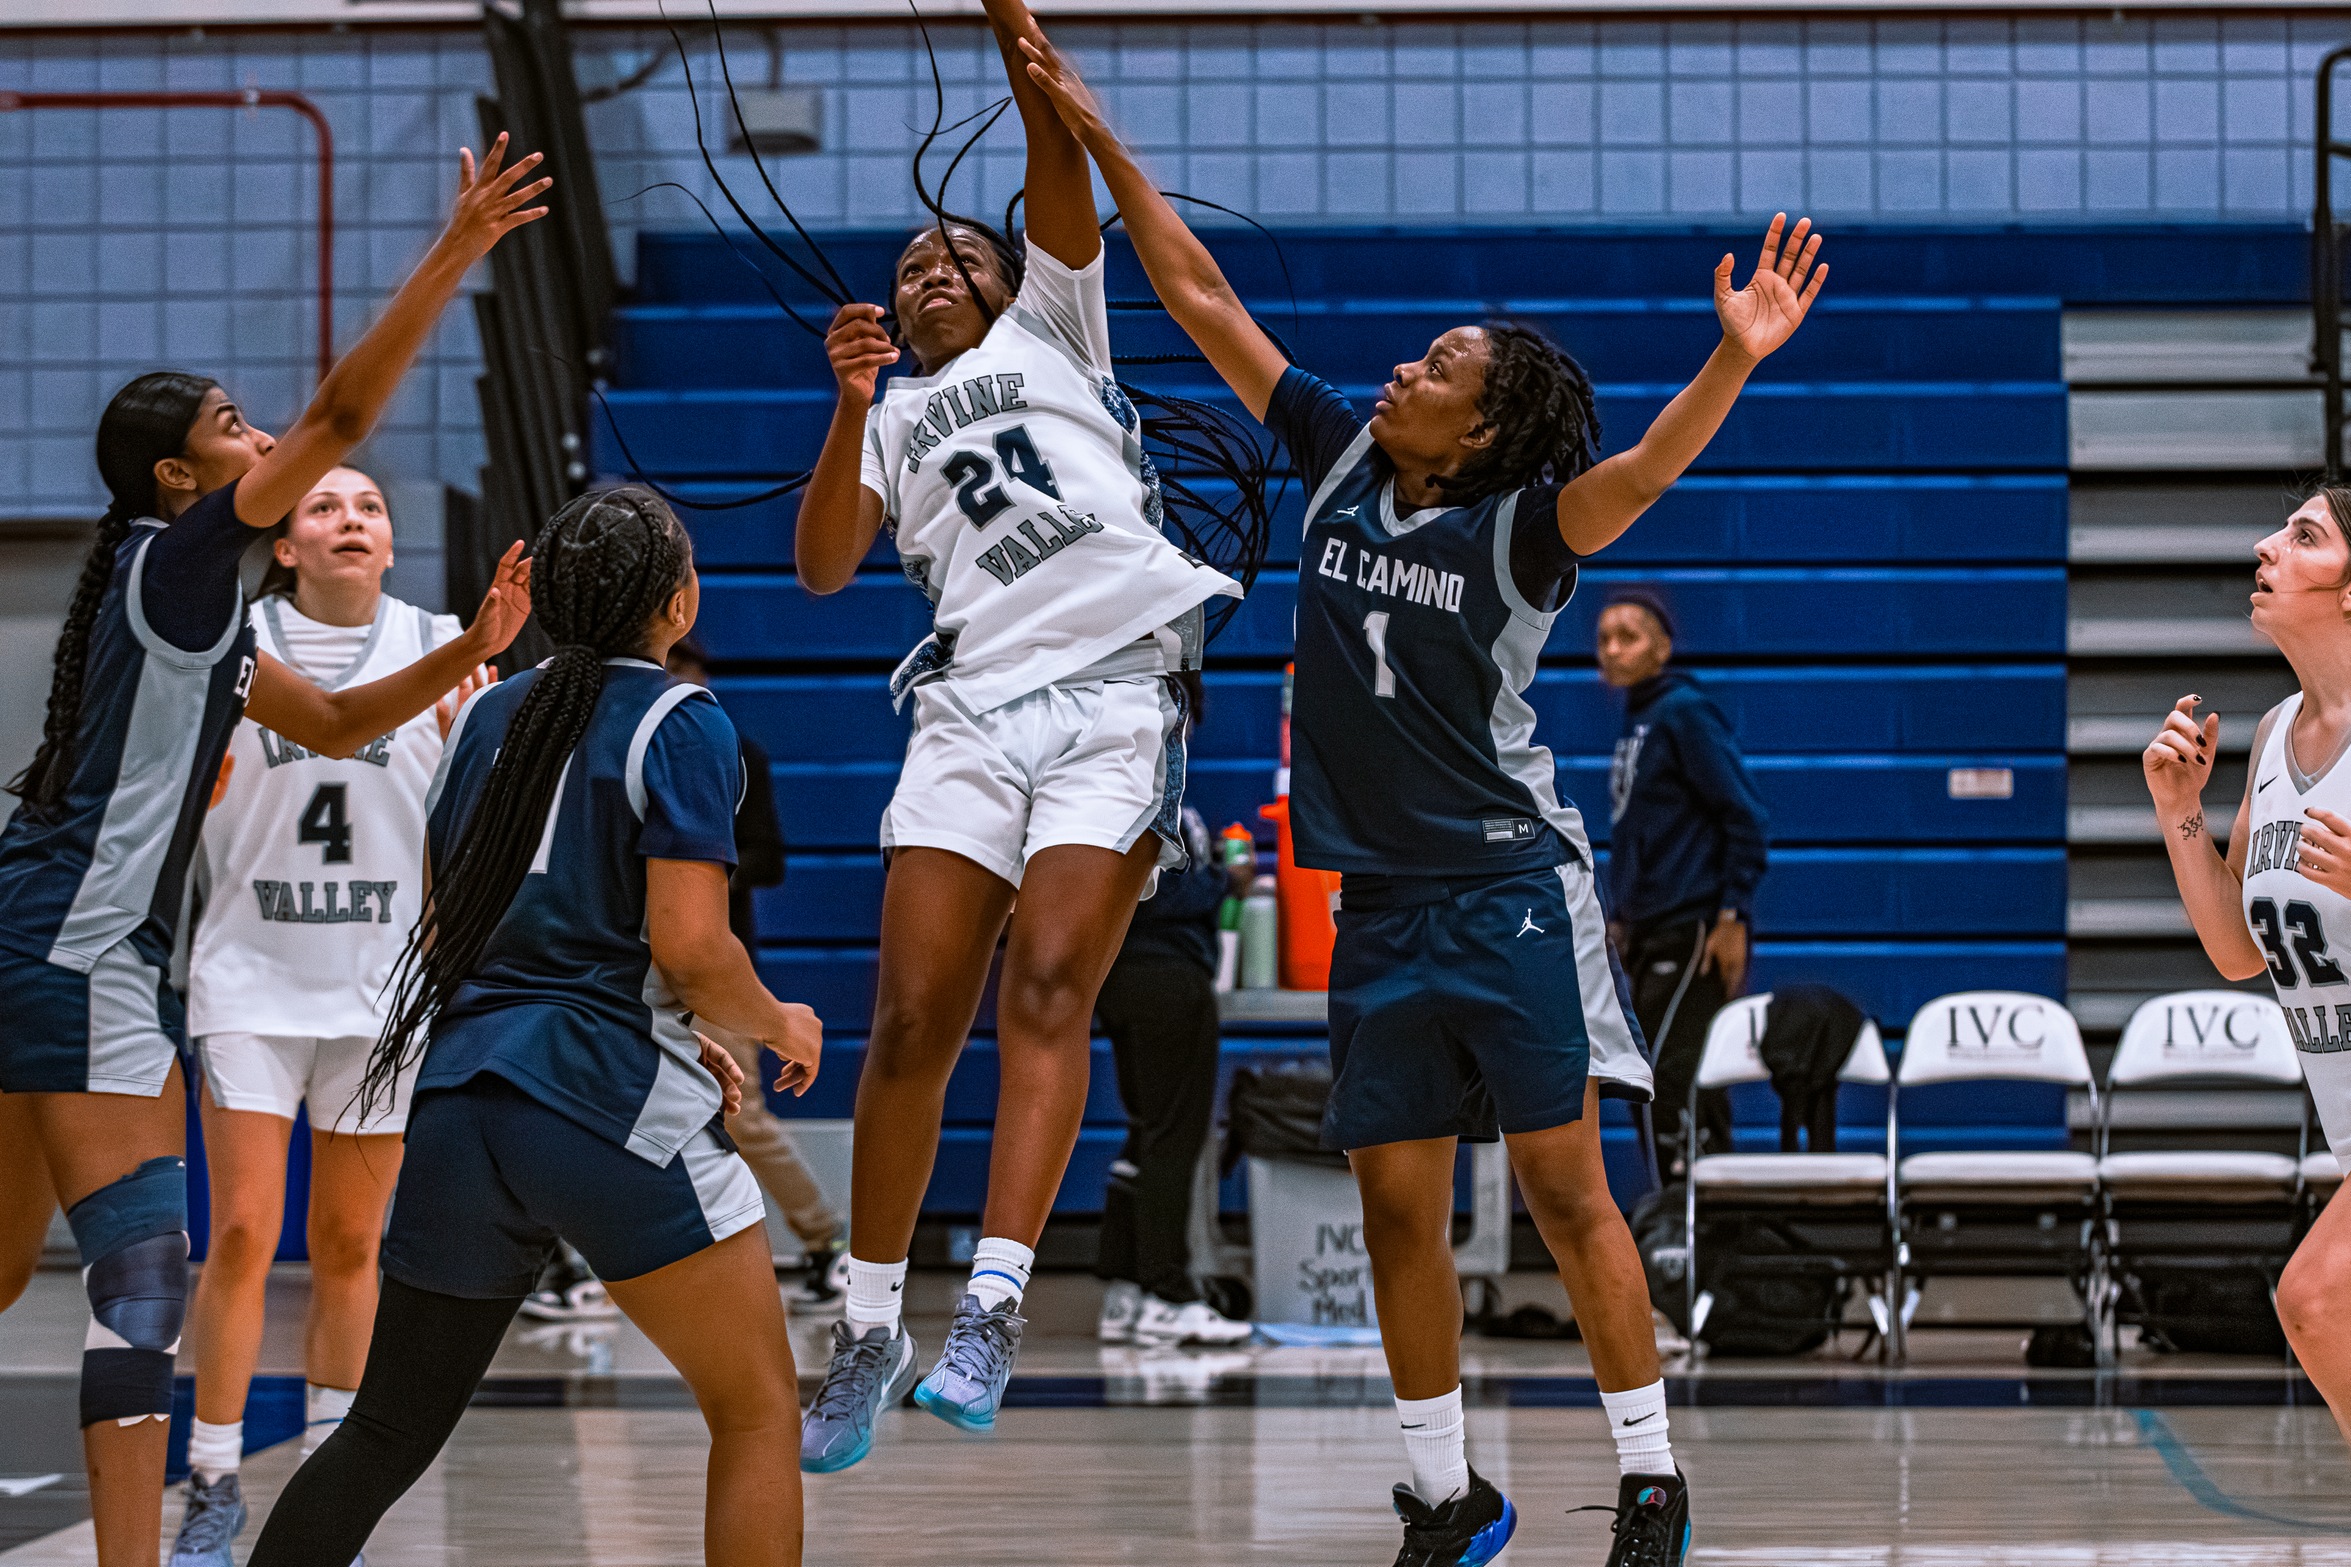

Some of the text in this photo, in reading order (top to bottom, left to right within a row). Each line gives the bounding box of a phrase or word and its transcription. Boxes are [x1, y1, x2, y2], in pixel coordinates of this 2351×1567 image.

[939, 422, 1065, 532] 24
[975, 504, 1105, 587] VALLE
[1318, 537, 1465, 613] EL CAMINO
[1363, 611, 1396, 699] 1
[298, 781, 353, 866] 4
[1518, 823, 1529, 834] M
[2247, 820, 2304, 879] IRVI
[253, 879, 398, 924] VALLEY
[2250, 896, 2350, 990] 32
[1946, 1005, 2045, 1050] IVC
[2163, 1005, 2261, 1050] IVC
[2281, 1003, 2351, 1054] ALLE
